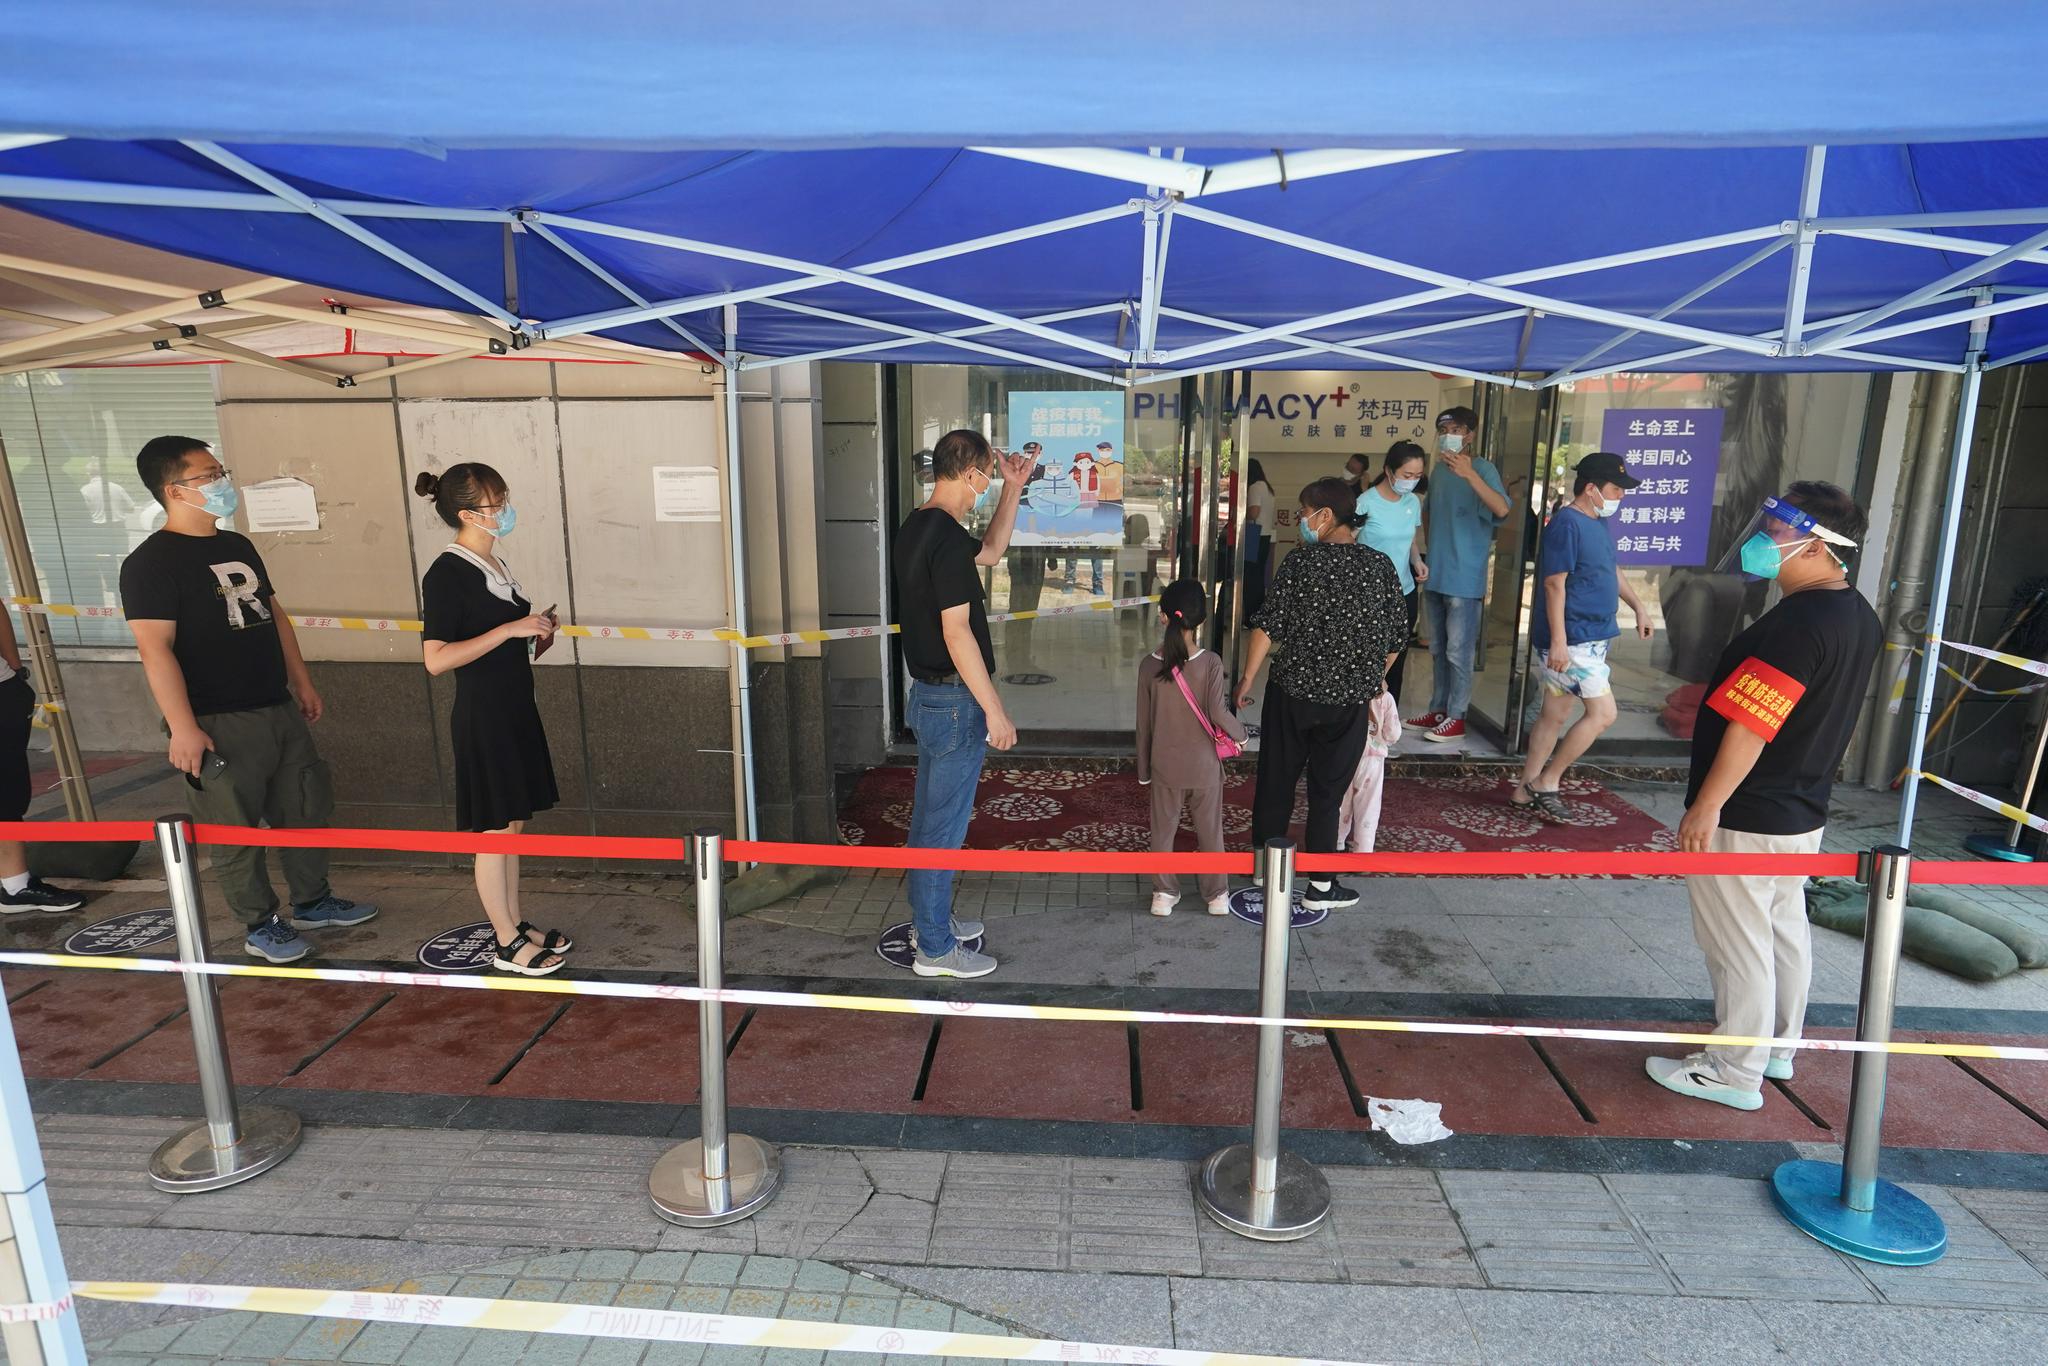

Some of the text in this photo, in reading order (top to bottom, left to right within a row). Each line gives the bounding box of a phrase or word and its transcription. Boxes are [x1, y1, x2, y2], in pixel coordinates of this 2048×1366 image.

[1031, 407, 1103, 421] 战疫有我
[1134, 392, 1327, 420] PHMACY
[1357, 399, 1429, 420] 梵玛西
[1031, 423, 1102, 437] 志愿献力
[1281, 424, 1425, 437] 皮肤管理中心
[1628, 419, 1695, 436] 生命至上
[1625, 449, 1692, 466] 举国同心
[1619, 507, 1685, 523] 尊重科学
[1617, 536, 1682, 552] 命运与共
[209, 561, 271, 629] R
